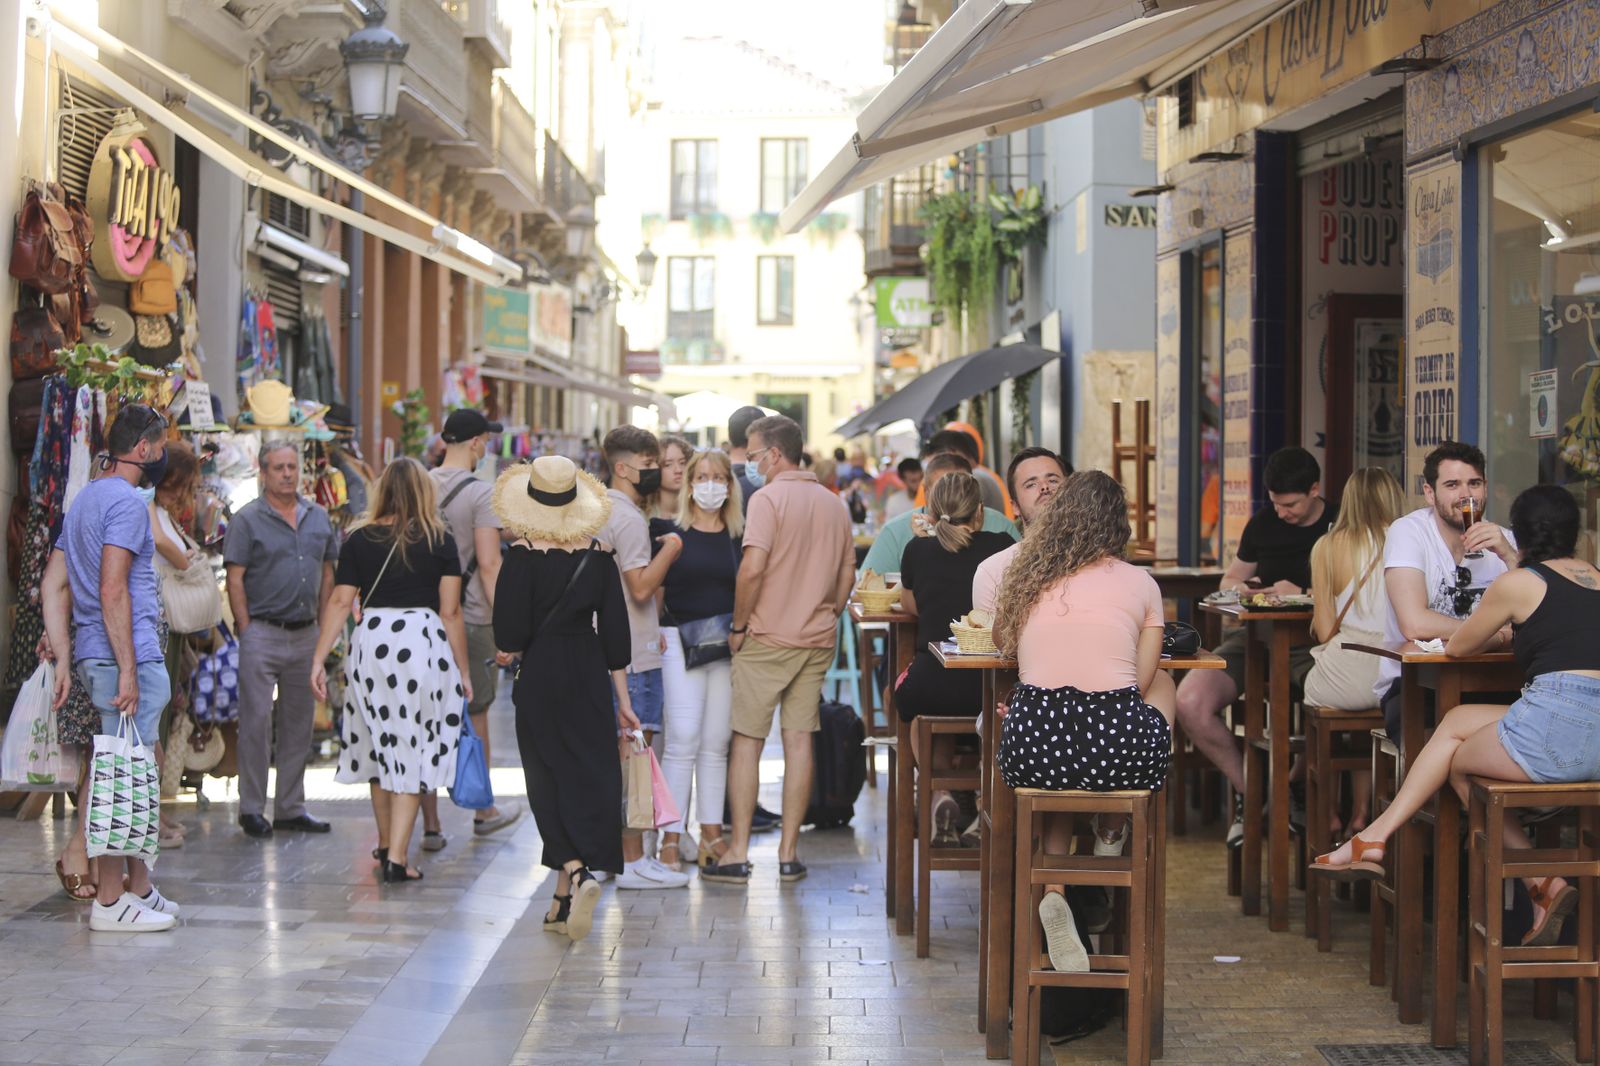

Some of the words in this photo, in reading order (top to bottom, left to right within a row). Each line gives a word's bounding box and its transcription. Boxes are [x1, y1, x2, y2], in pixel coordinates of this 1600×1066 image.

[1415, 186, 1435, 218] Casa
[1434, 176, 1454, 213] Lola
[1320, 210, 1403, 266] PROP
[1414, 353, 1443, 384] VERMUT
[1414, 388, 1454, 447] GRIFO
